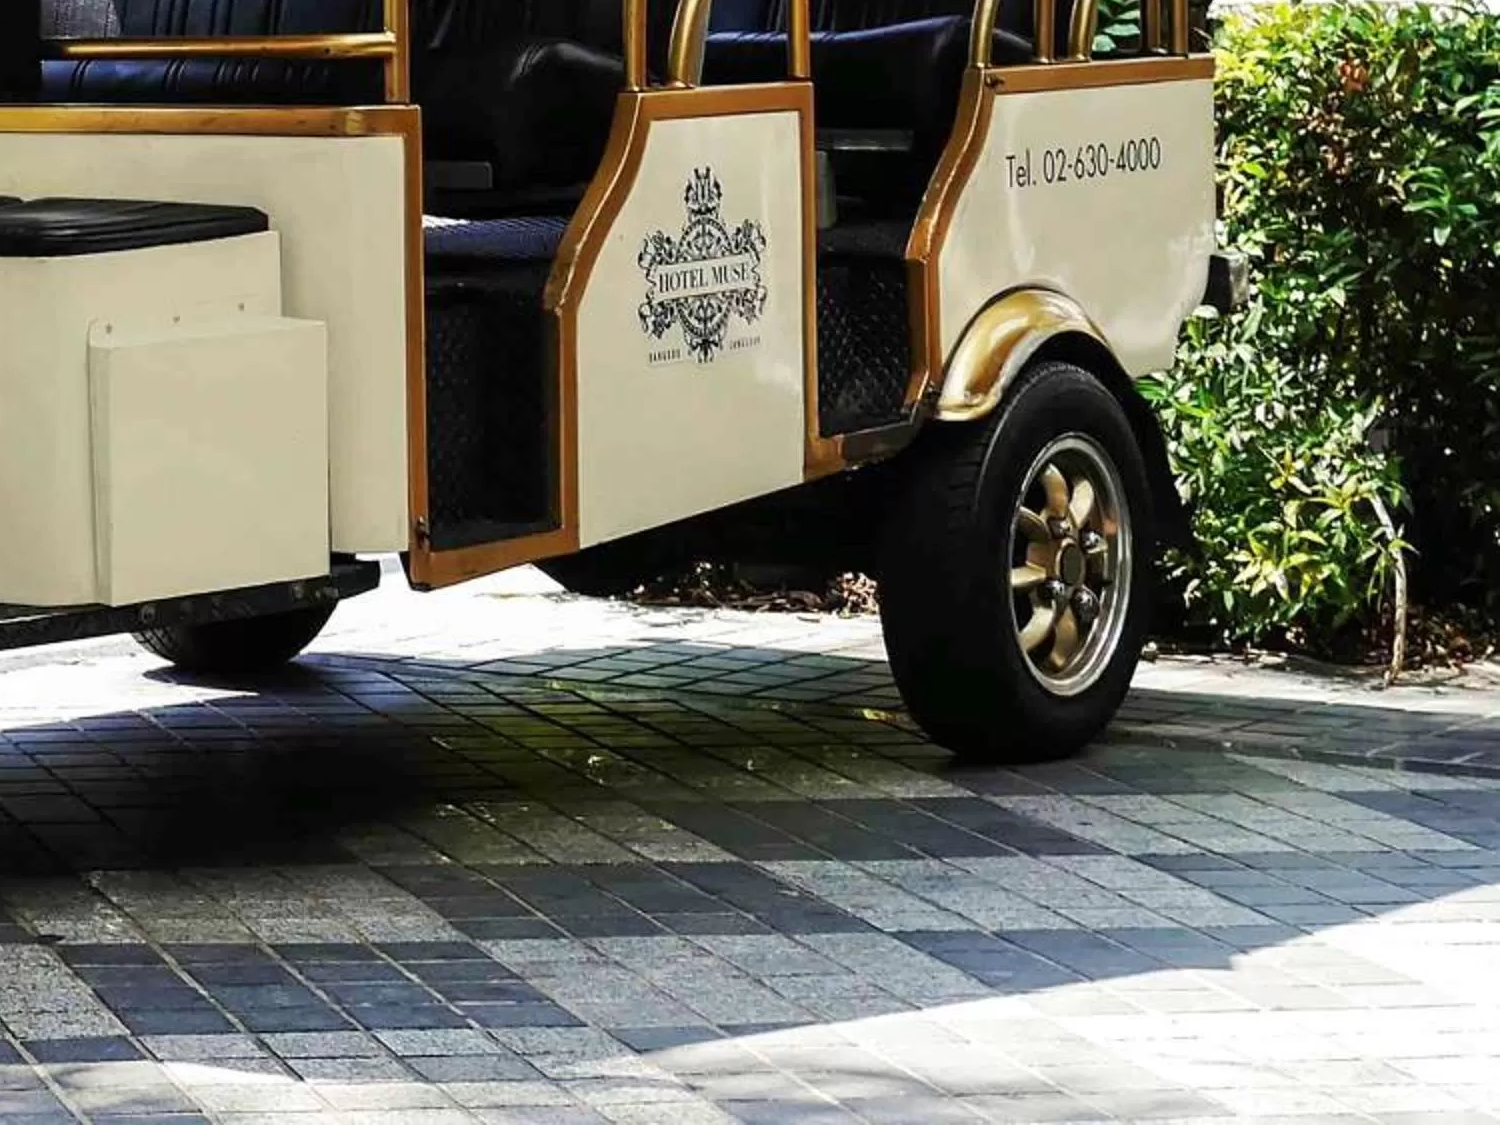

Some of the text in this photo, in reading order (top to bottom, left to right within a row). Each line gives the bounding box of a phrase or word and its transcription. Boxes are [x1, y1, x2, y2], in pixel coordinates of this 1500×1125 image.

[1006, 136, 1162, 188] Tel. 02-630-4000
[659, 262, 749, 293] HOTEL MUSE
